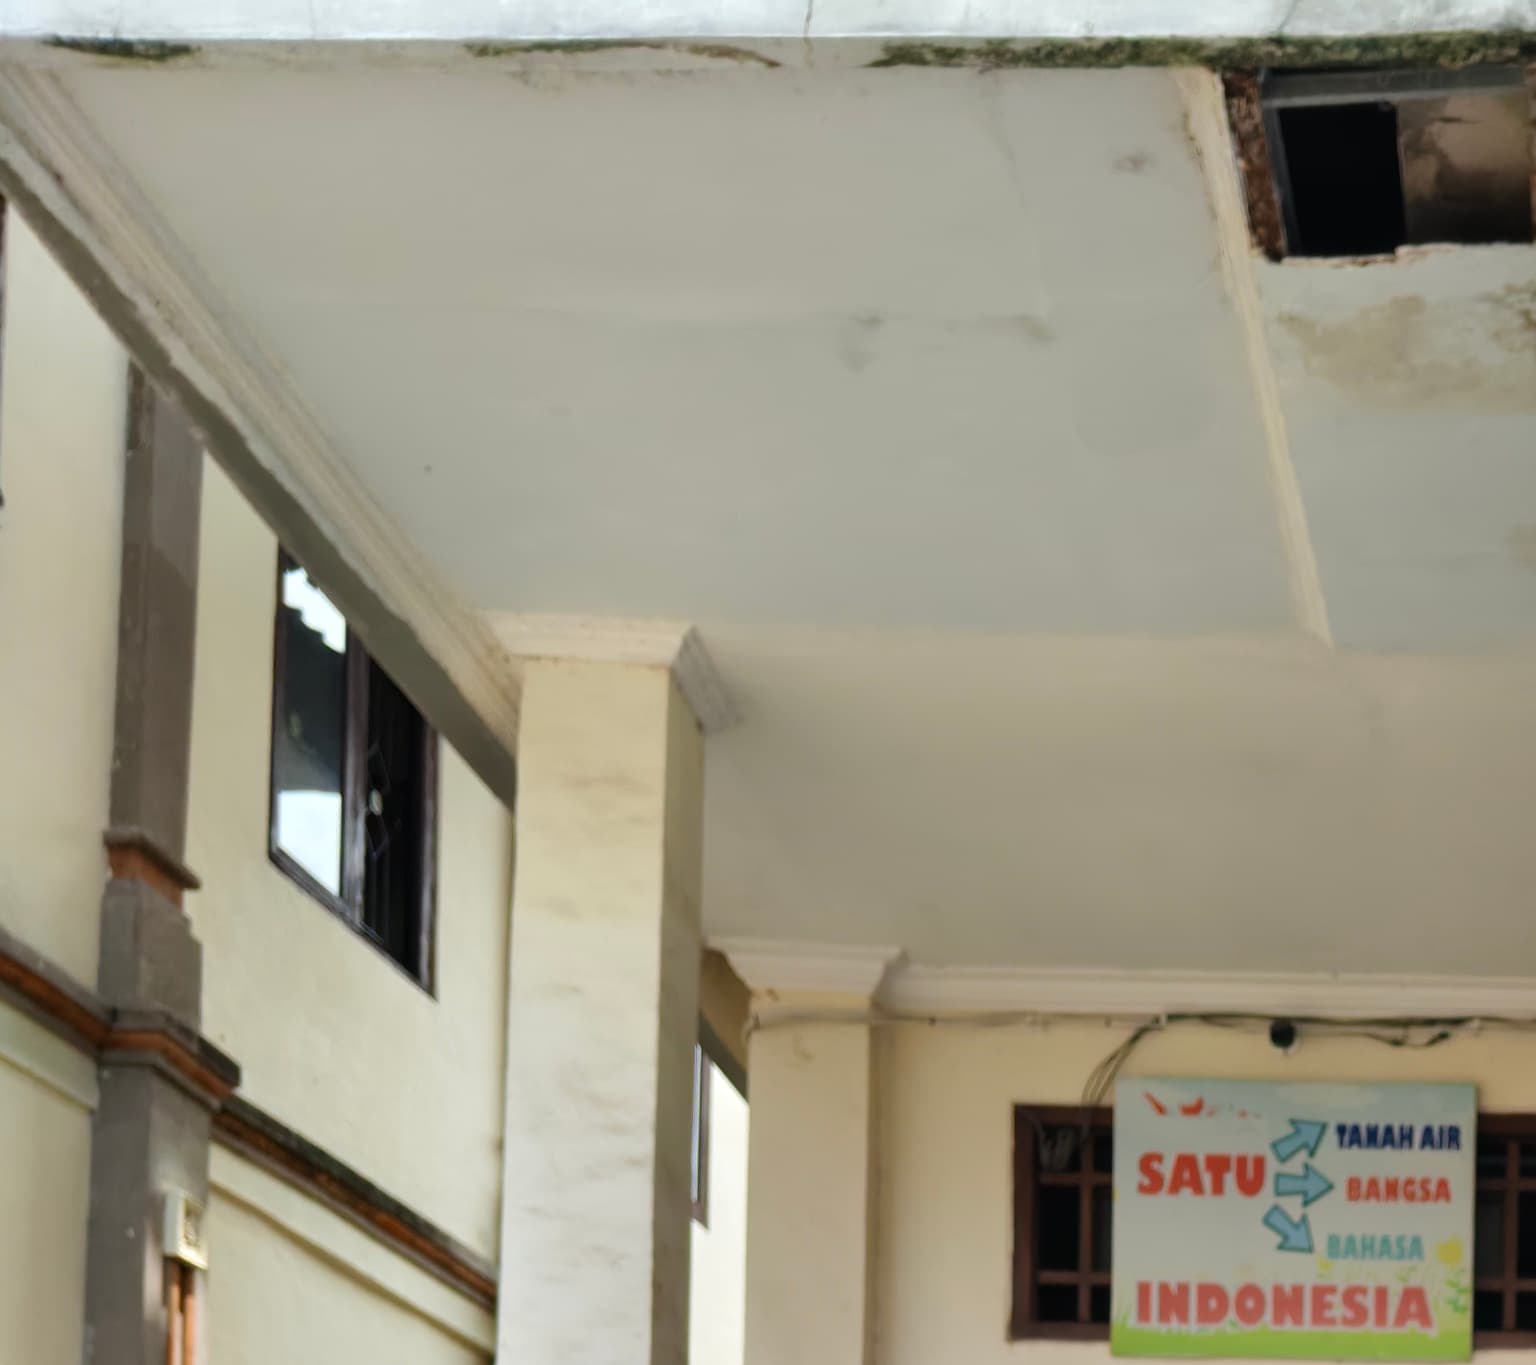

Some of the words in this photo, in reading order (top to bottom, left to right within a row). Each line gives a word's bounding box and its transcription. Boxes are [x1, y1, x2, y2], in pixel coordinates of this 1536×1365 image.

[1336, 1123, 1413, 1150] TANAH
[1419, 1125, 1462, 1151] AIR
[1137, 1152, 1266, 1197] SATU
[1346, 1176, 1452, 1203] BANGSA
[1326, 1234, 1425, 1261] BAHASA
[1136, 1281, 1433, 1330] INDONESIA
